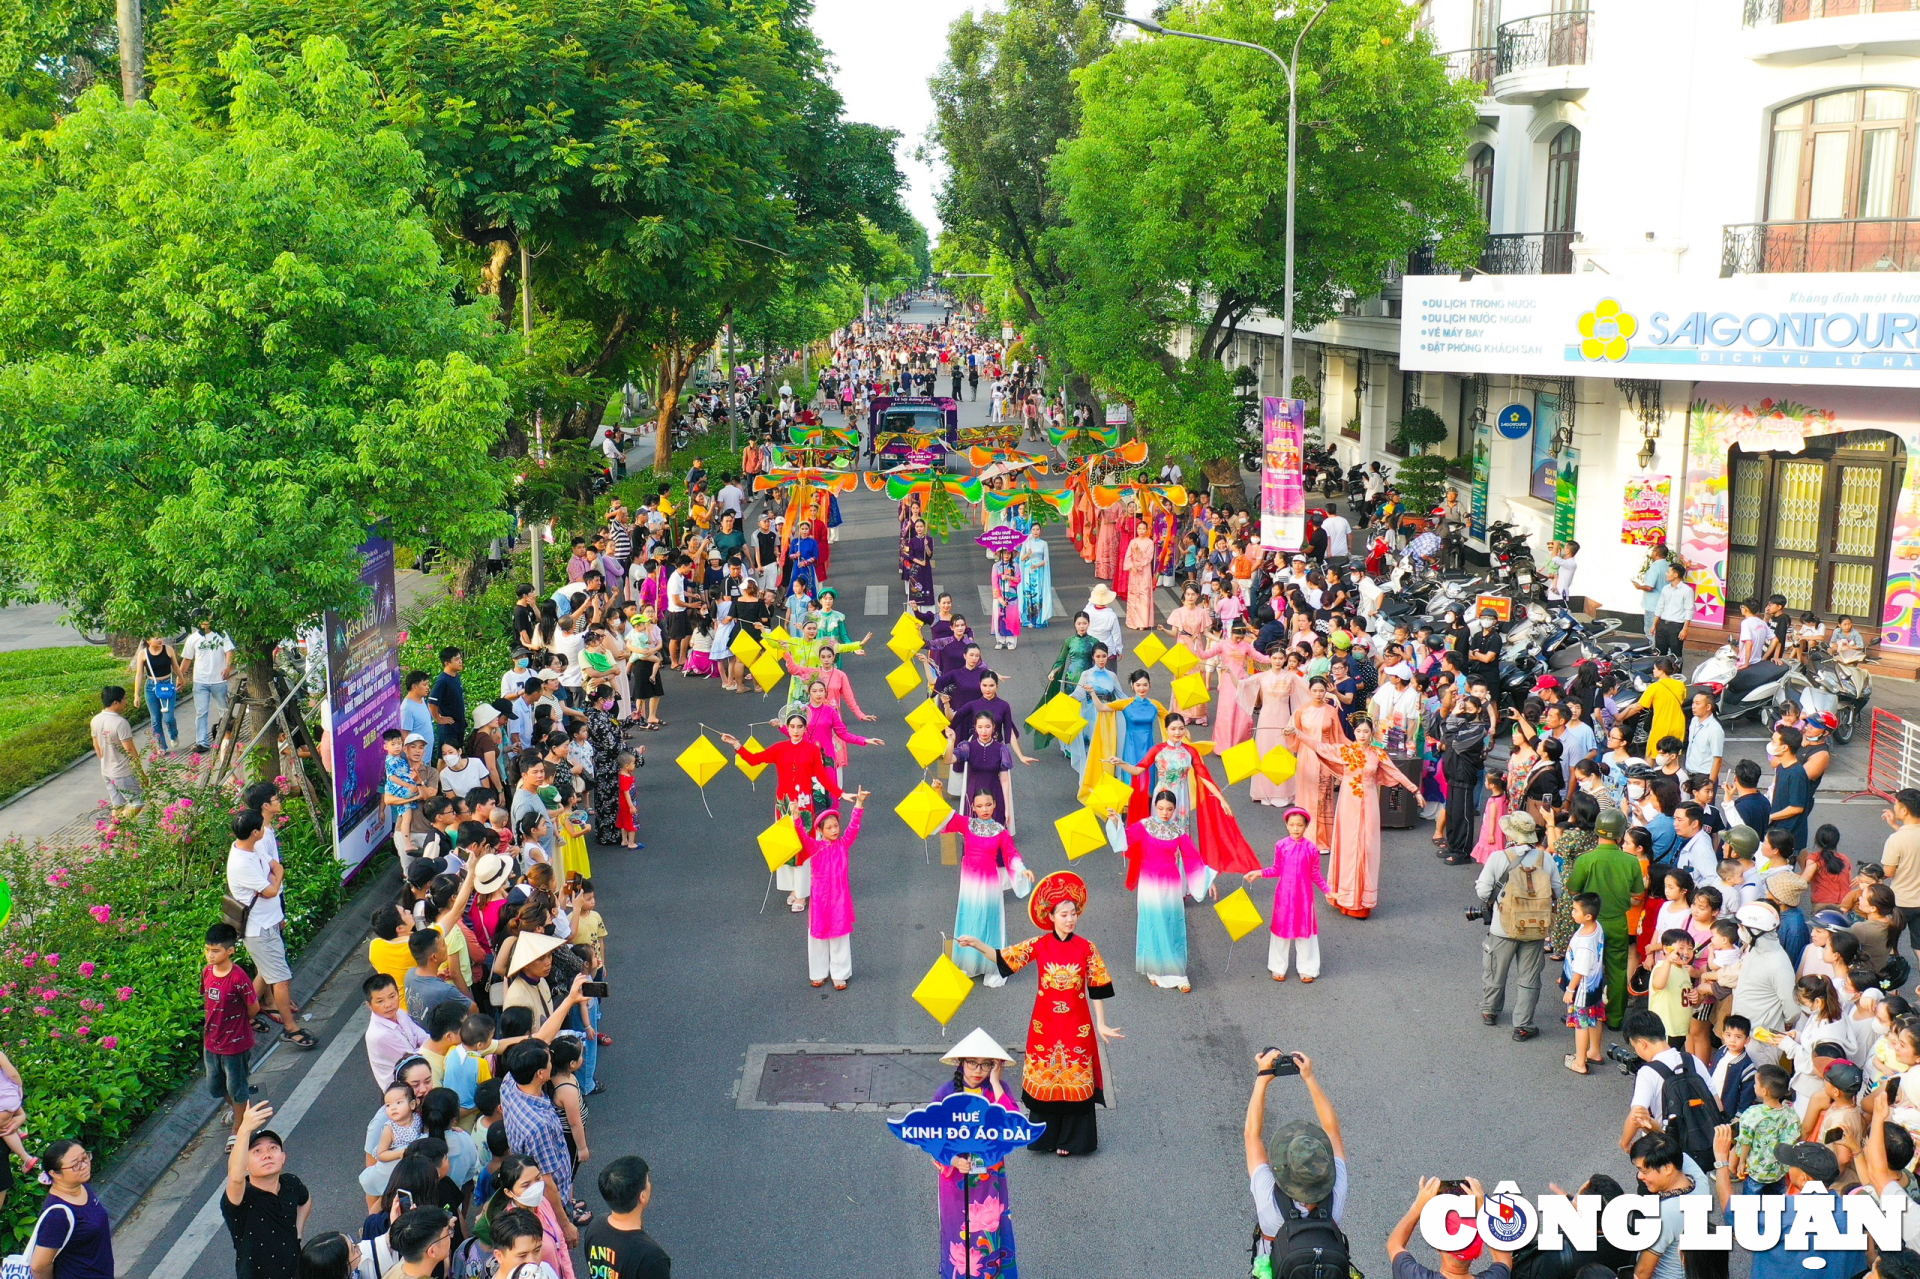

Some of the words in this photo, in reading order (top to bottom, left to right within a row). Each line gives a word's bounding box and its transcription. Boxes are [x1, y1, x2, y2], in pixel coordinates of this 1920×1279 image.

[1429, 299, 1442, 308] DU
[1444, 299, 1466, 310] LỊCH
[1470, 299, 1505, 309] TRONG
[1428, 314, 1442, 323] DU
[1443, 314, 1466, 325] LỊCH
[1443, 327, 1462, 338] MÁY
[1465, 329, 1484, 338] BAY
[1448, 342, 1481, 353] PHÒNG
[1484, 342, 1519, 354] KHÁCH
[1701, 353, 1761, 365] DỊCH
[1782, 354, 1810, 366] VỤ
[1681, 988, 1693, 1007] 6
[952, 1110, 981, 1123] HUẾ
[902, 1126, 943, 1139] KINH
[946, 1125, 971, 1140] ĐÔ
[974, 1125, 999, 1140] ÁO
[1003, 1126, 1031, 1141] DÀI
[590, 1245, 617, 1266] ANTI
